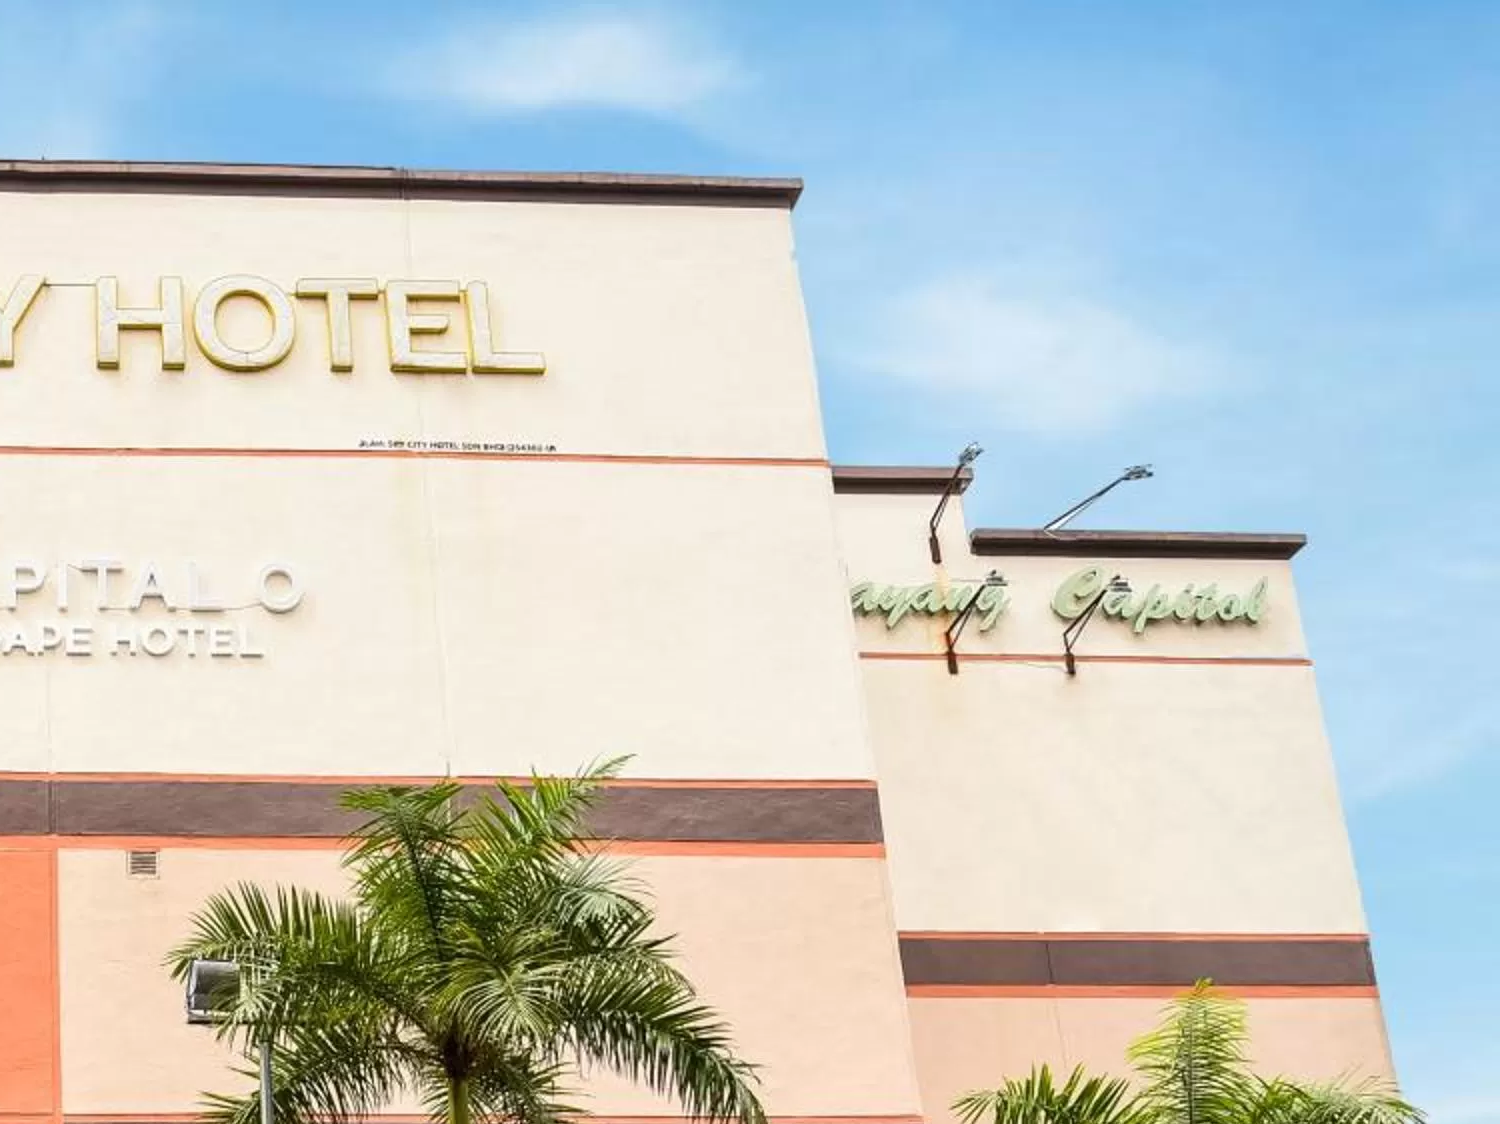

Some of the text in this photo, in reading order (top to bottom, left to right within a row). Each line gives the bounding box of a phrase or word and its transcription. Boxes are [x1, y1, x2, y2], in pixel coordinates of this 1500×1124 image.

[95, 275, 546, 375] HOTEL
[258, 561, 308, 614] O
[851, 581, 1011, 632] ayang
[108, 623, 265, 658] HOTEL
